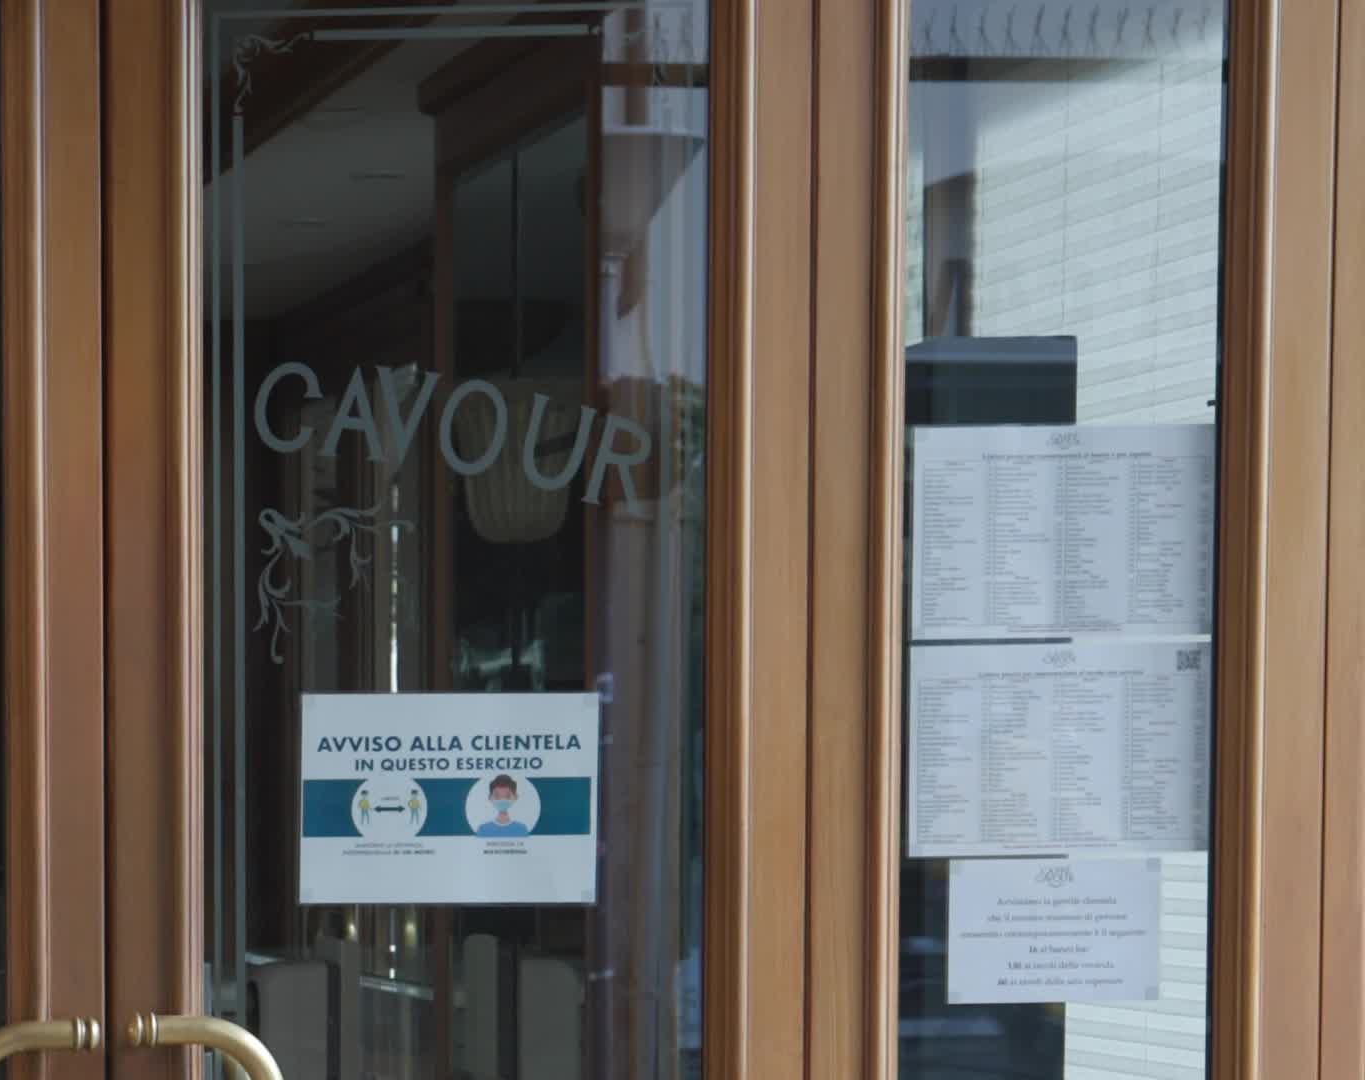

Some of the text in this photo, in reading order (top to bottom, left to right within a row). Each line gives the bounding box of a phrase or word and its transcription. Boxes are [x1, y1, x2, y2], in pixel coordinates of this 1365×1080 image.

[253, 361, 653, 514] CAVOUR
[317, 734, 582, 753] AVVISO ALLA CLIENTELA
[355, 756, 543, 772] IN QUESTO ESERCIZIO
